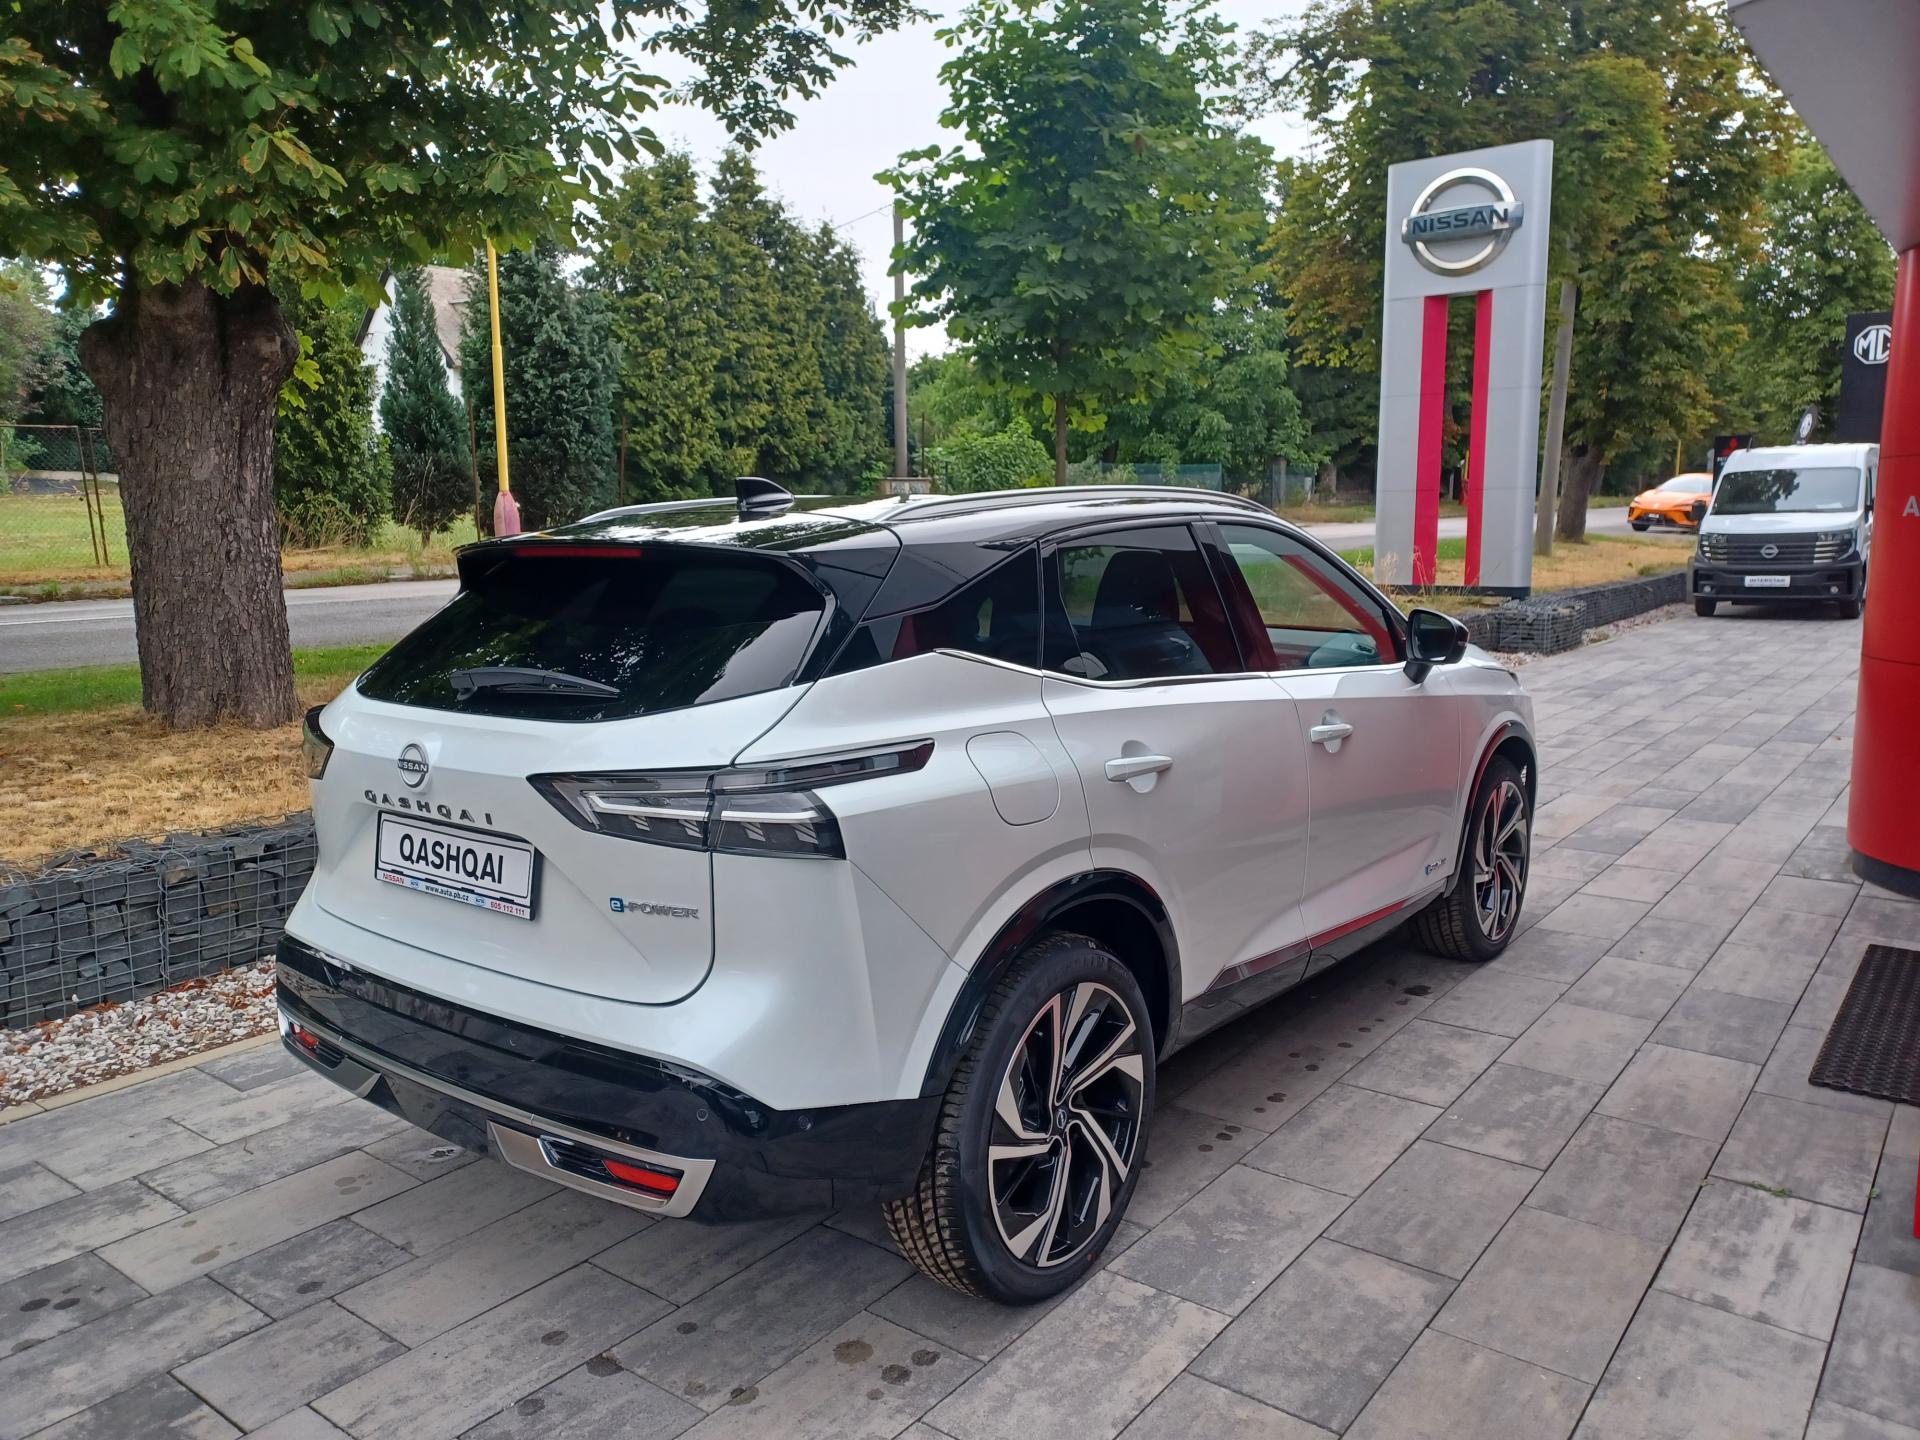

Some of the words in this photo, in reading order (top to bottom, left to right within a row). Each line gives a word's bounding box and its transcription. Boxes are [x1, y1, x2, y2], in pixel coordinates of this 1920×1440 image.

[1412, 207, 1508, 235] NISSAN
[364, 790, 493, 825] QASHQAI
[400, 833, 504, 884] QASHQAI
[382, 872, 405, 885] NISSAN
[503, 904, 514, 913] 112
[515, 907, 525, 916] 111
[610, 897, 699, 919] e-POWER
